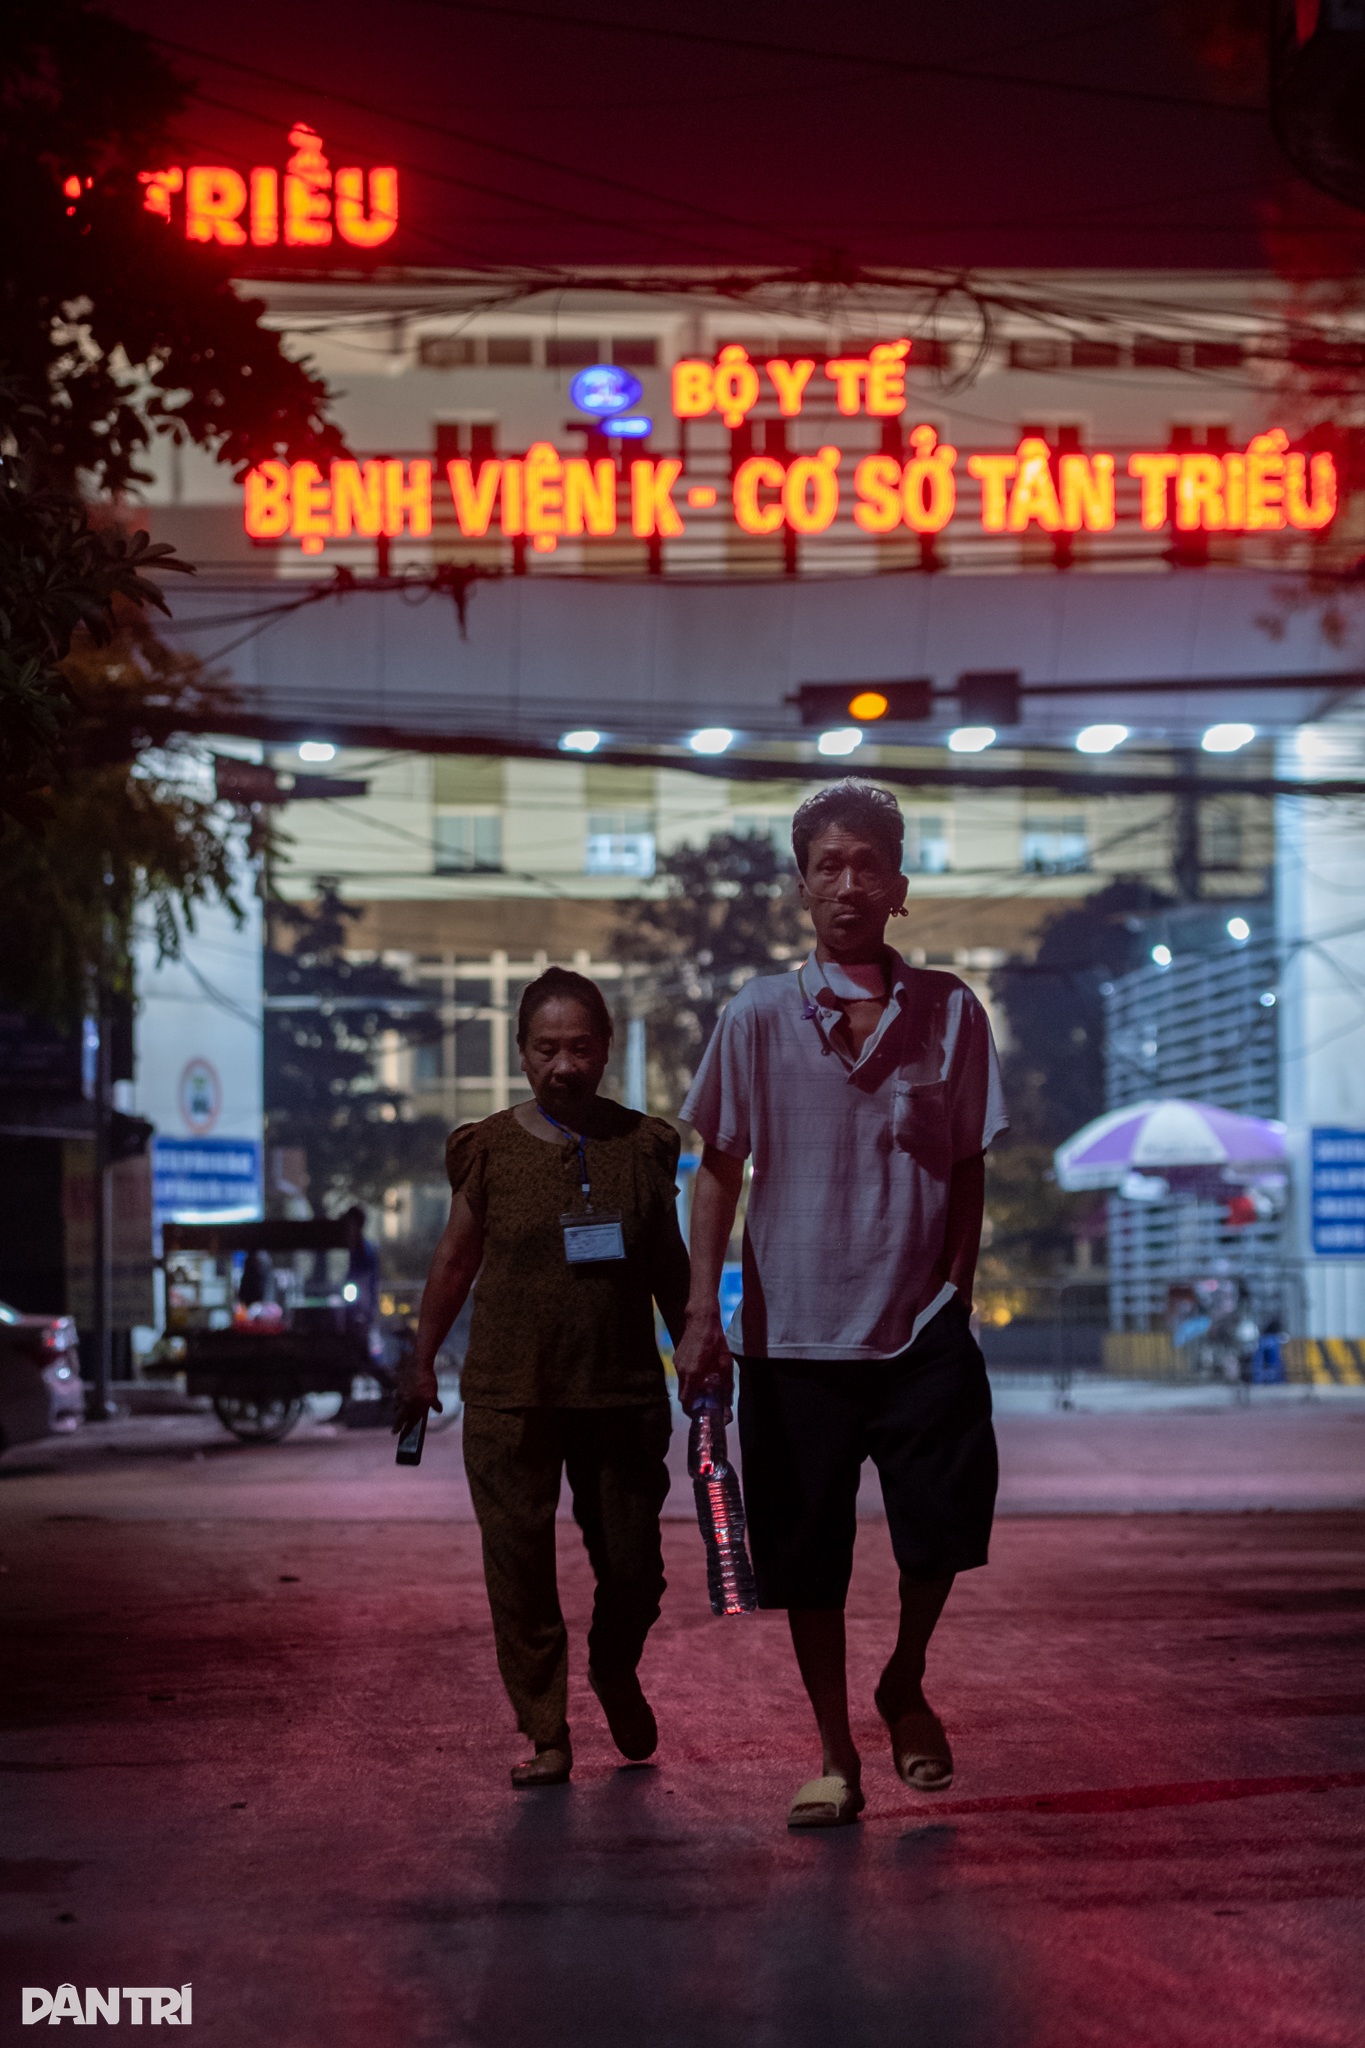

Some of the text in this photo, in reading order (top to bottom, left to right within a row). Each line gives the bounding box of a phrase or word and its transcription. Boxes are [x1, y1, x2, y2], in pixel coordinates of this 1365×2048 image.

[671, 338, 913, 429] BỘ Y TẾ
[446, 441, 617, 554] VIỆN
[630, 458, 686, 538] K
[732, 445, 842, 535] CƠ
[852, 424, 959, 534] SỞ
[965, 437, 1117, 534] TÂN
